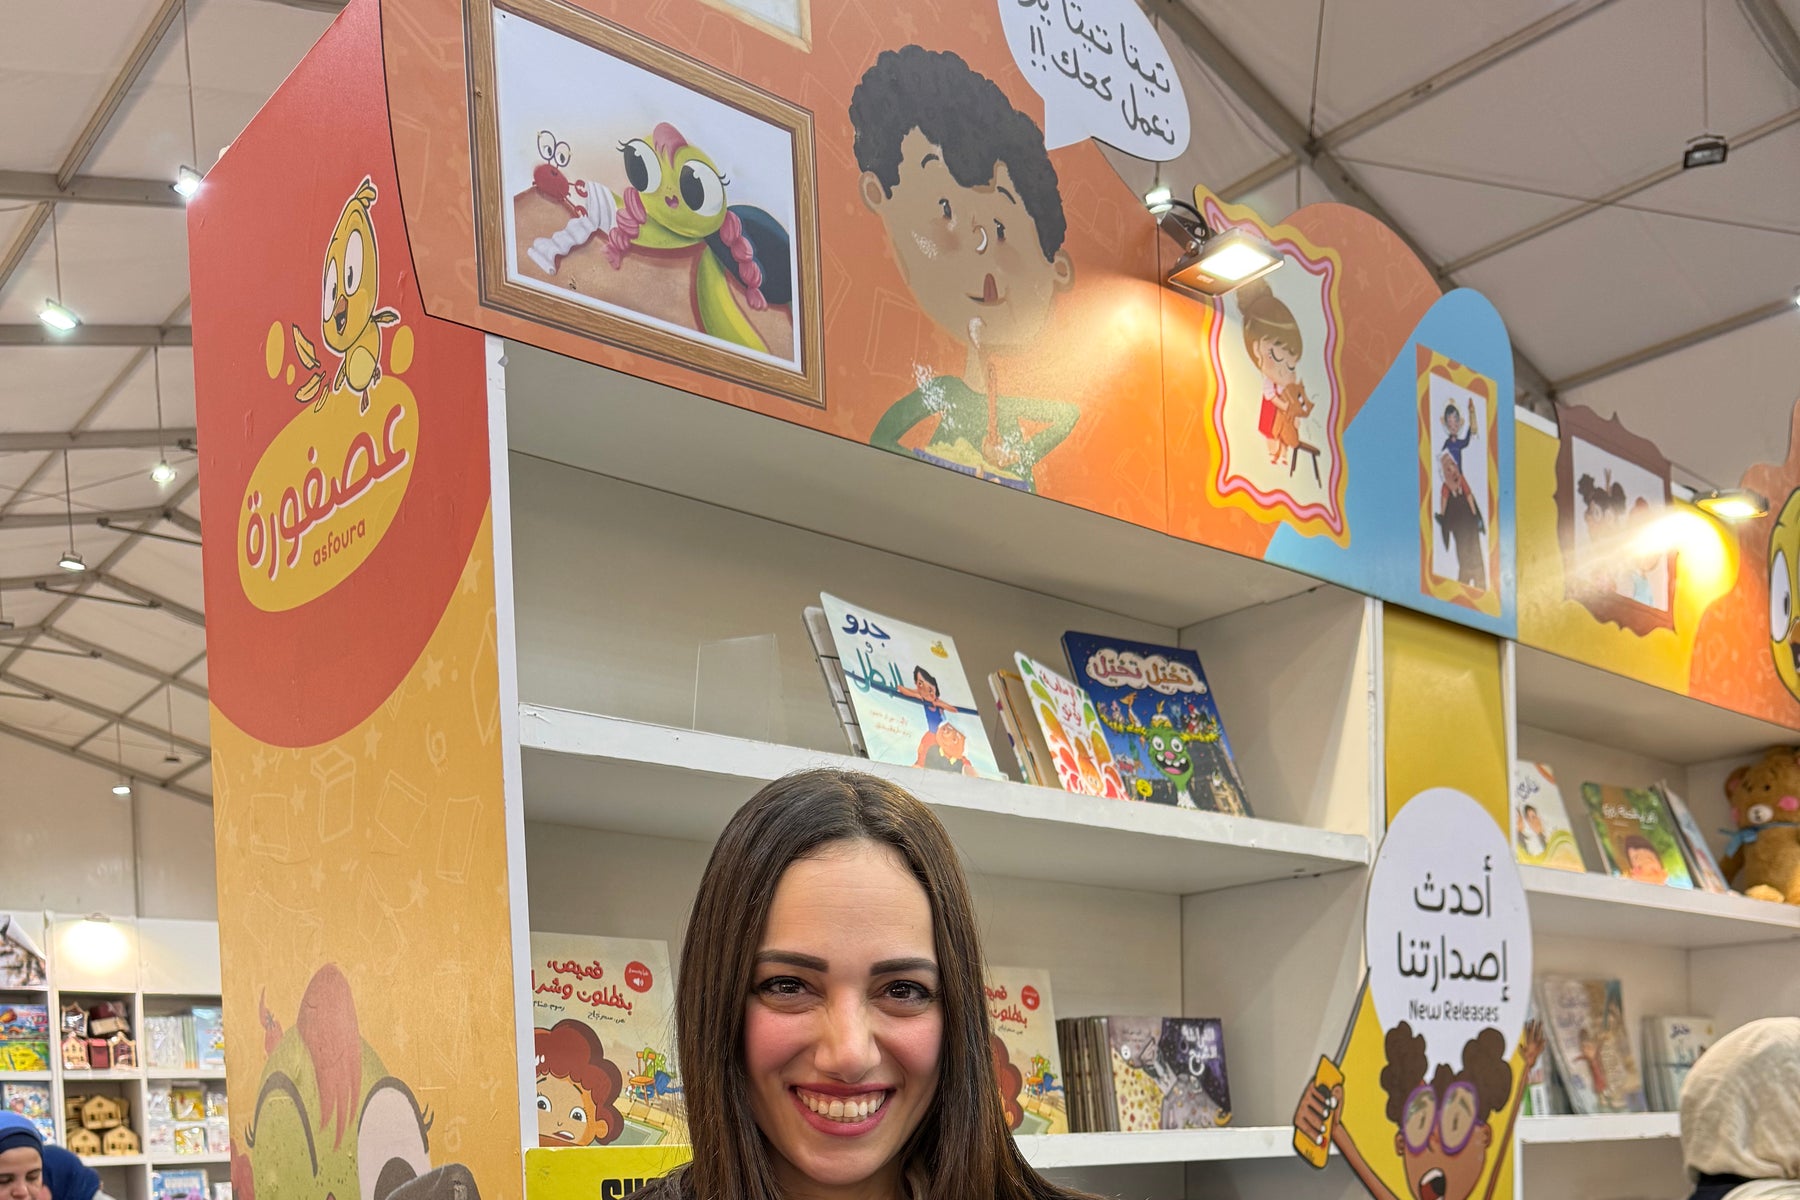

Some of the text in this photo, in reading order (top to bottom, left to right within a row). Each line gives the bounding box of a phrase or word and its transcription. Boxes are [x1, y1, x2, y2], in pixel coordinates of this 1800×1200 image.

[1121, 83, 1175, 145] نعمل
[246, 403, 409, 582] عصفورة
[313, 519, 366, 566] asfoura
[842, 613, 891, 648] جدو
[1414, 856, 1492, 918] أحدث
[1398, 931, 1510, 1002] إصدارتنا
[577, 984, 632, 1016] بنطلون
[1409, 1000, 1499, 1022] New Releases
